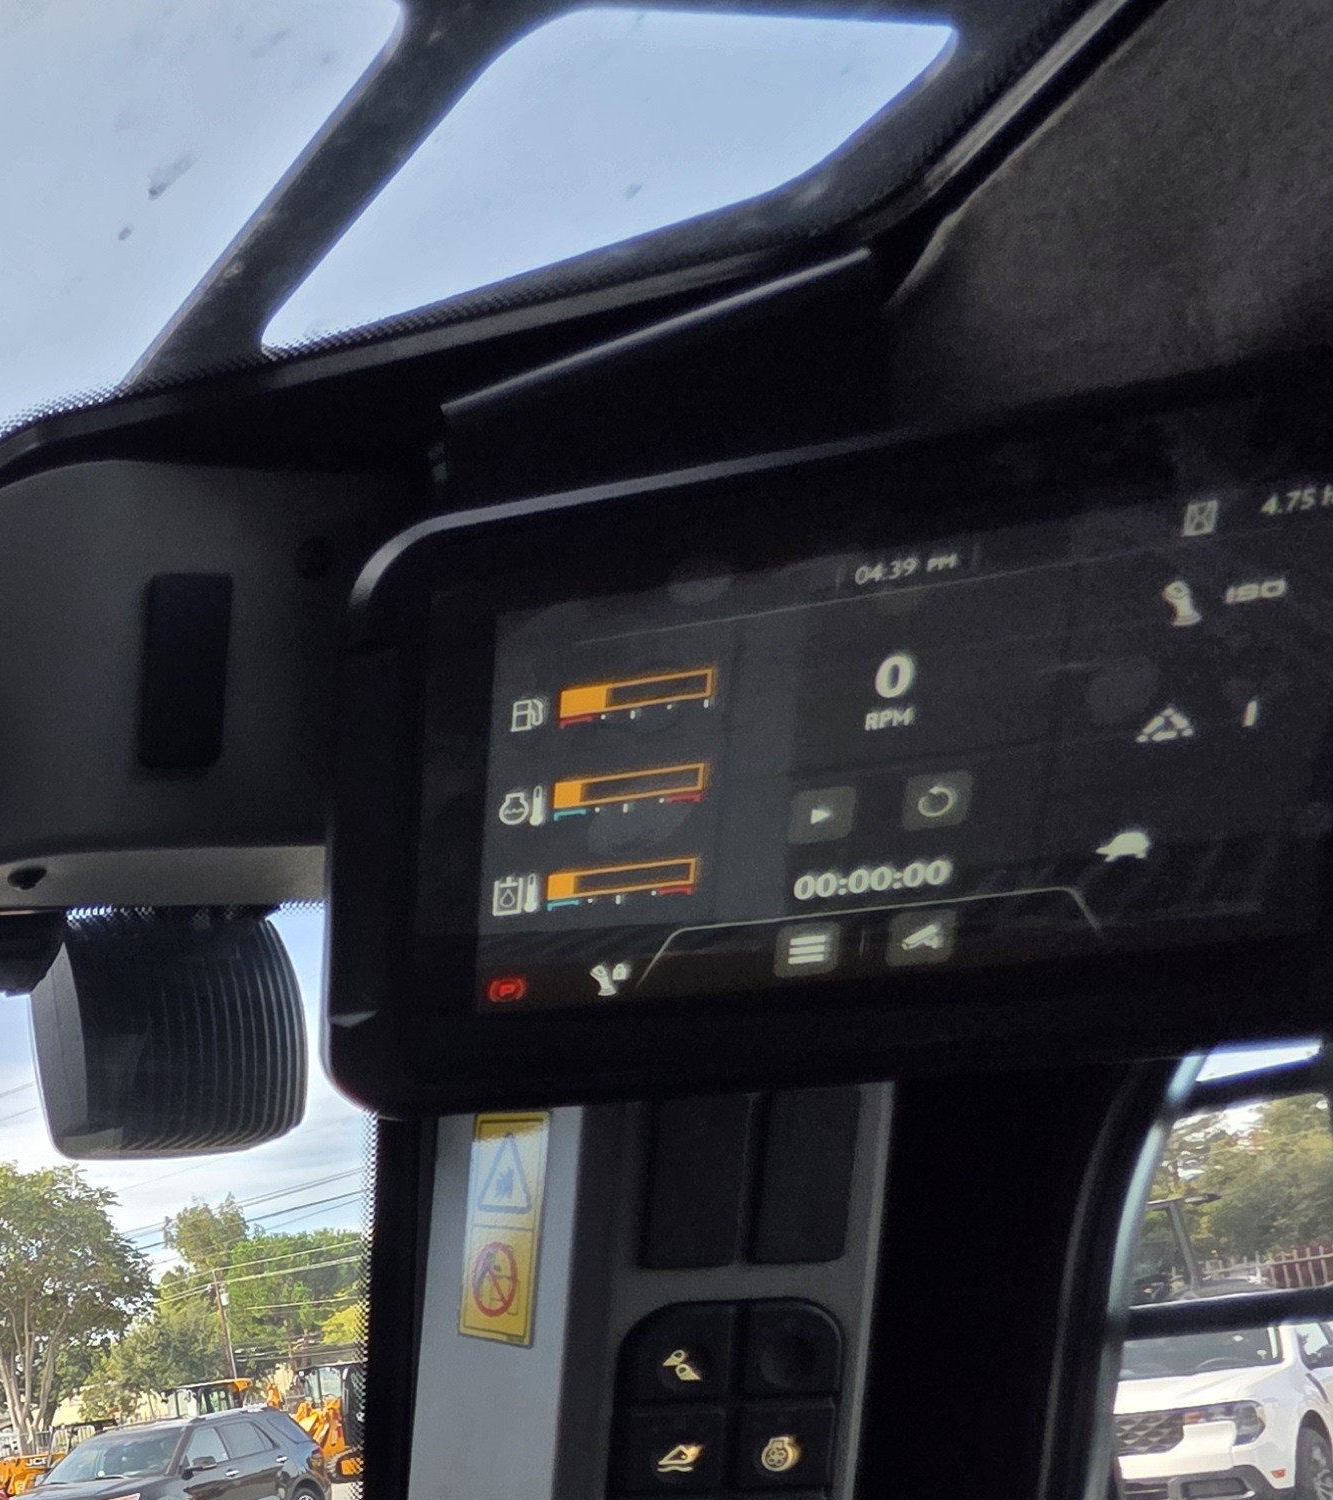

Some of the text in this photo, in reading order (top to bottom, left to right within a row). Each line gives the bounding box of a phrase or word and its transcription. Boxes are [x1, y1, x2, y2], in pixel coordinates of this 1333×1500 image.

[1260, 487, 1317, 516] 4.75
[854, 552, 959, 586] 04:39 PM
[1225, 577, 1288, 605] ISO
[873, 651, 917, 700] 0
[863, 706, 914, 732] RPM
[792, 858, 954, 902] 00:00:00
